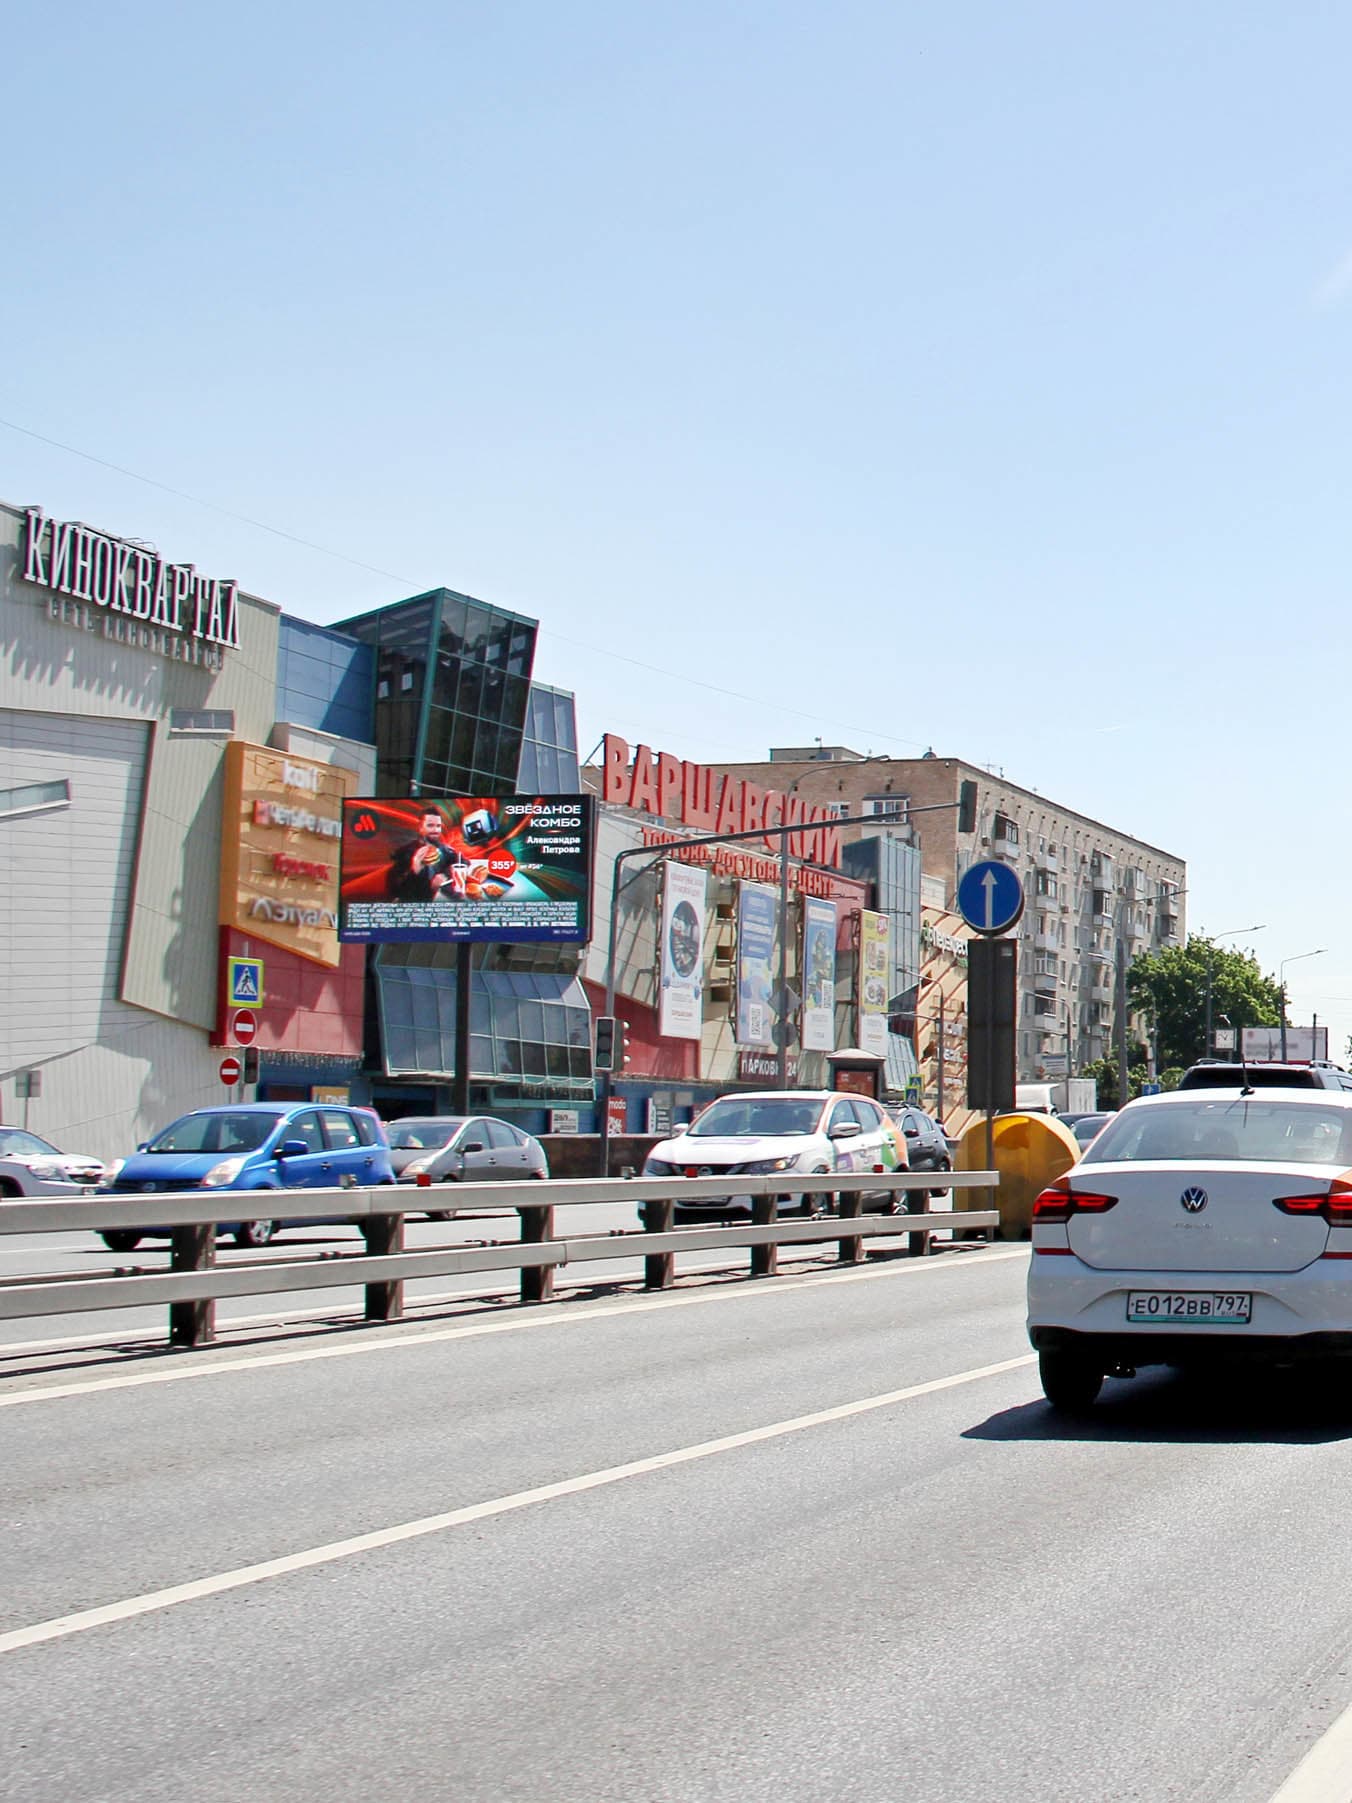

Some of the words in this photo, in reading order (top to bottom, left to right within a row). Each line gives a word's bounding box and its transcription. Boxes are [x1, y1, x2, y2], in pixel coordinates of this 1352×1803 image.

[24, 509, 242, 650] КИНОКВАРТАЛ
[603, 733, 843, 869] ВАРШАВСКИЙ
[505, 803, 582, 815] ЗВЁЗДНОЕ
[530, 818, 581, 827] КОМБО
[526, 836, 581, 845] Александра
[542, 846, 580, 854] Петрова
[1135, 1295, 1211, 1315] Е012ВВ
[1215, 1295, 1246, 1310] 797
